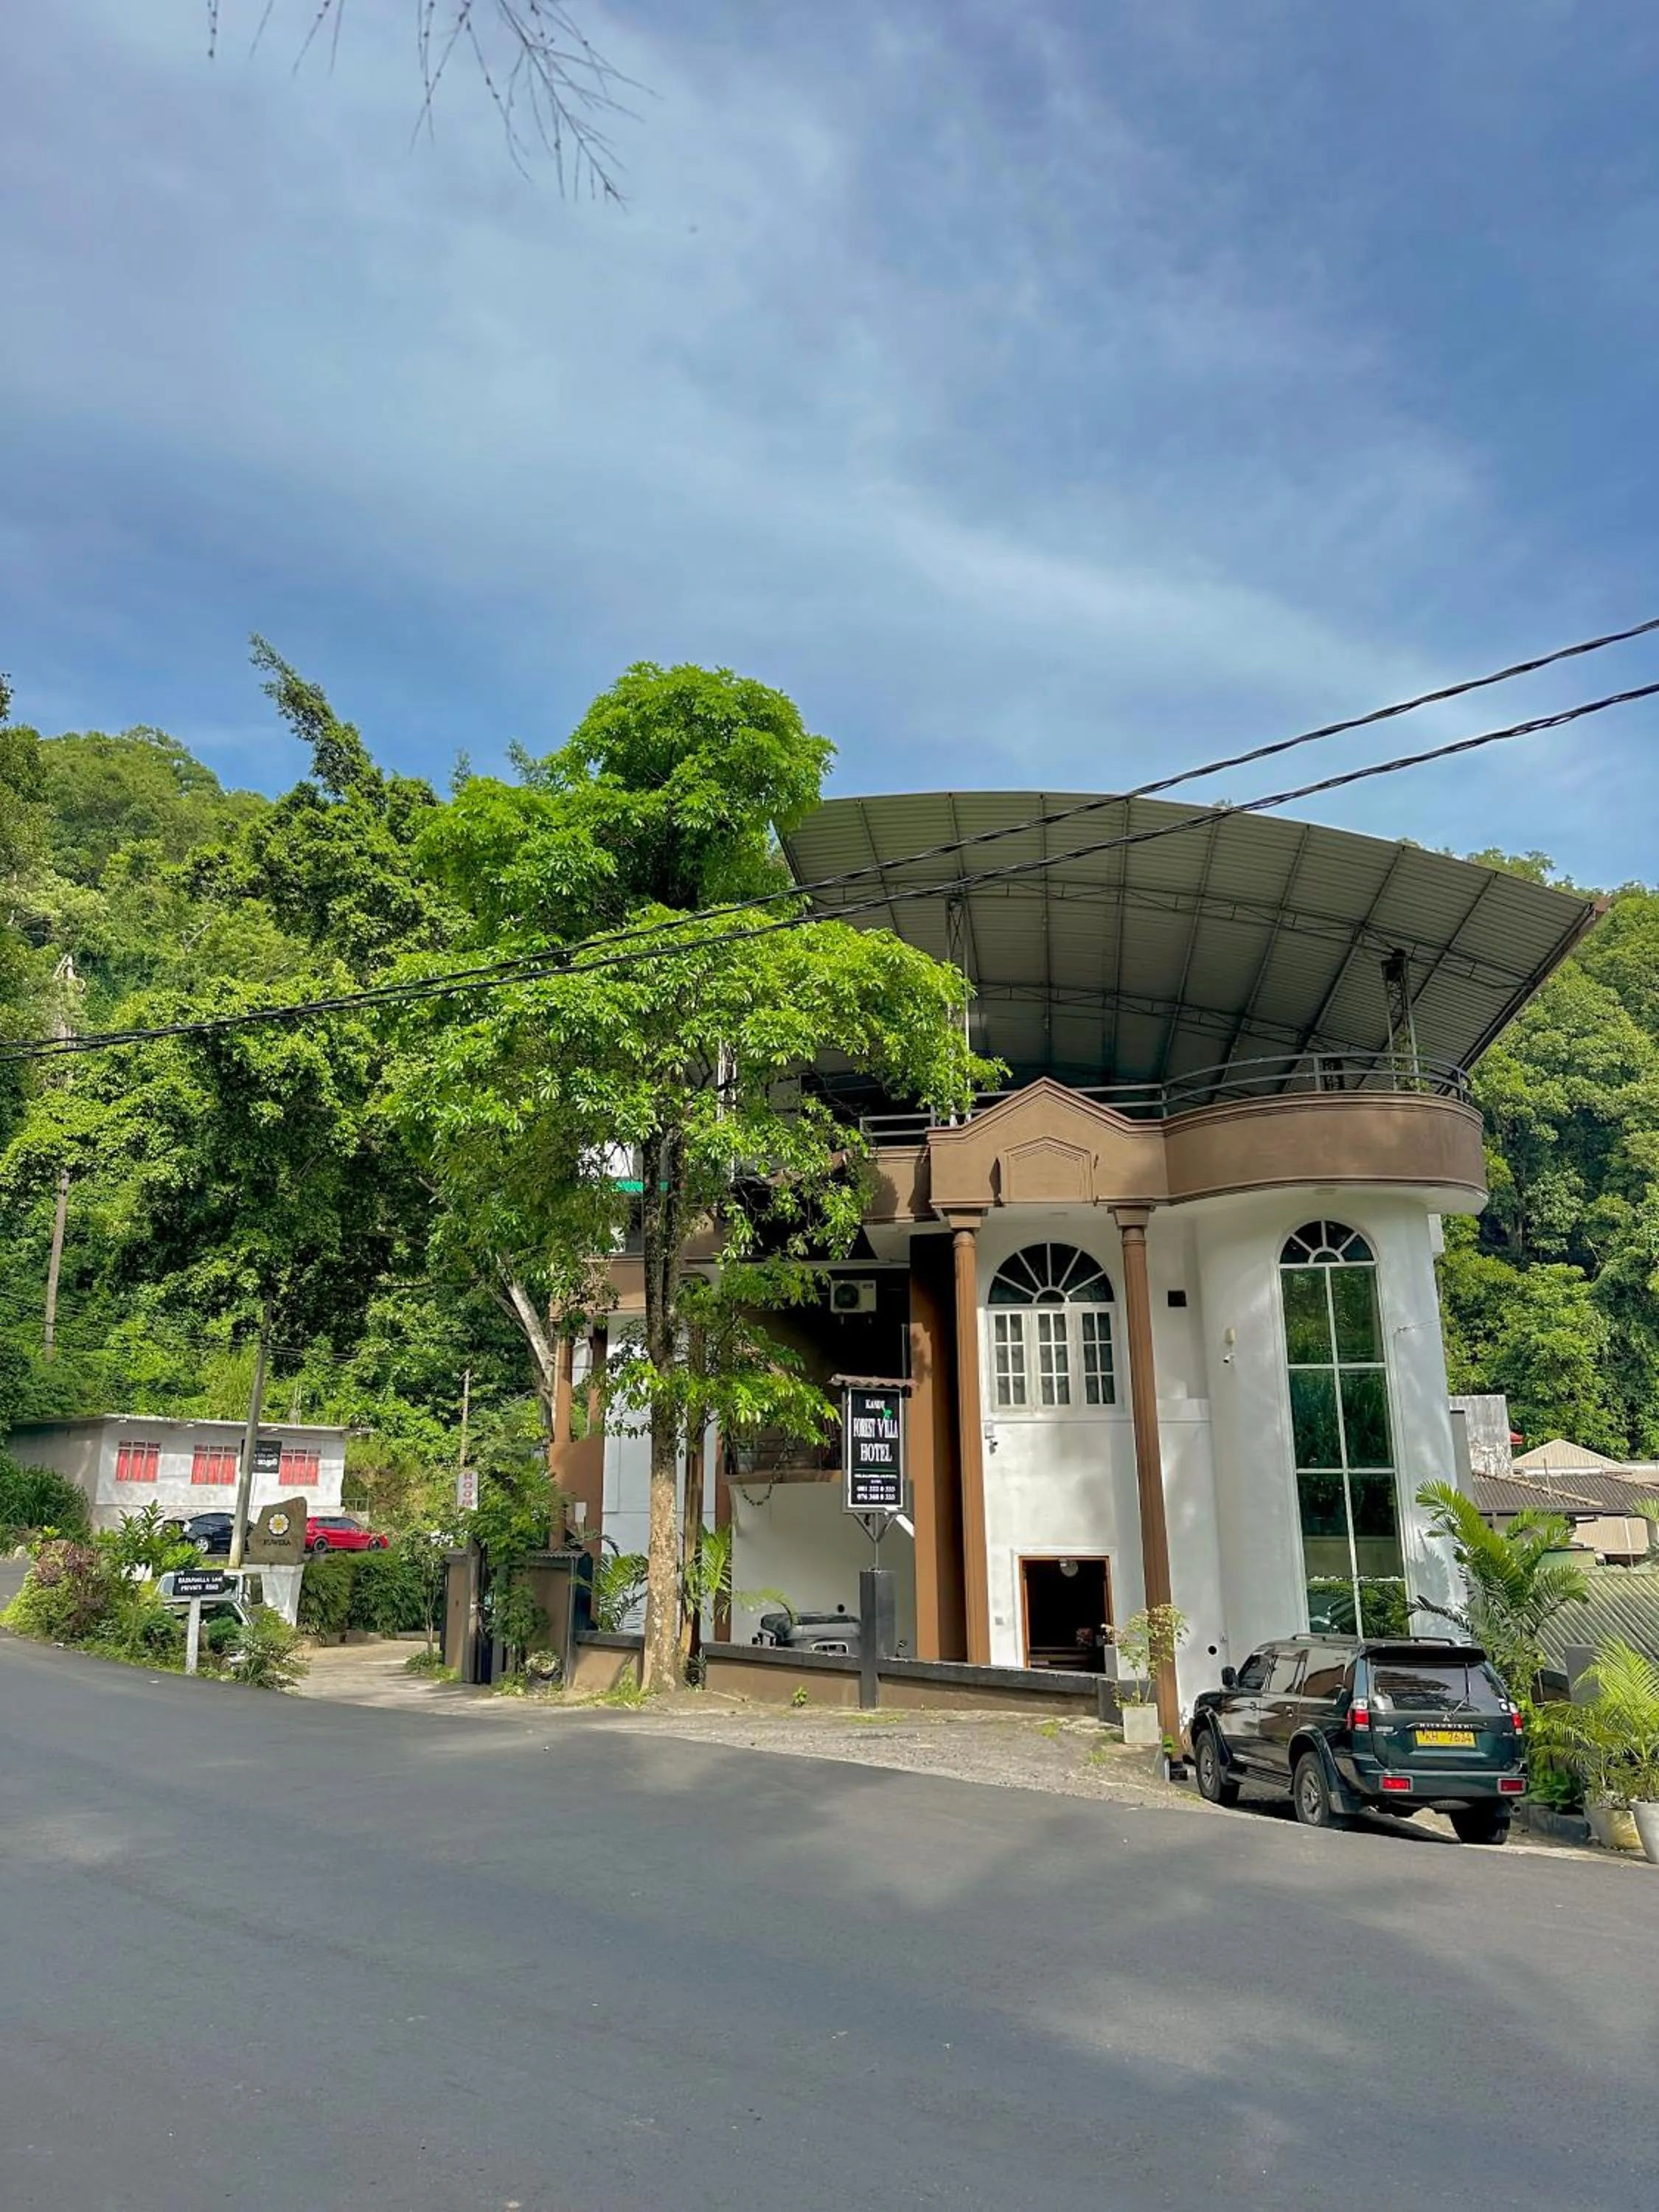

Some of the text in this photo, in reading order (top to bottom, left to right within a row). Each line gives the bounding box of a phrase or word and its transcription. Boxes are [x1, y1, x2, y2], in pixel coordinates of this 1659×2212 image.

[853, 1417, 898, 1439] FOREST VILLA
[860, 1443, 892, 1462] HOTEL
